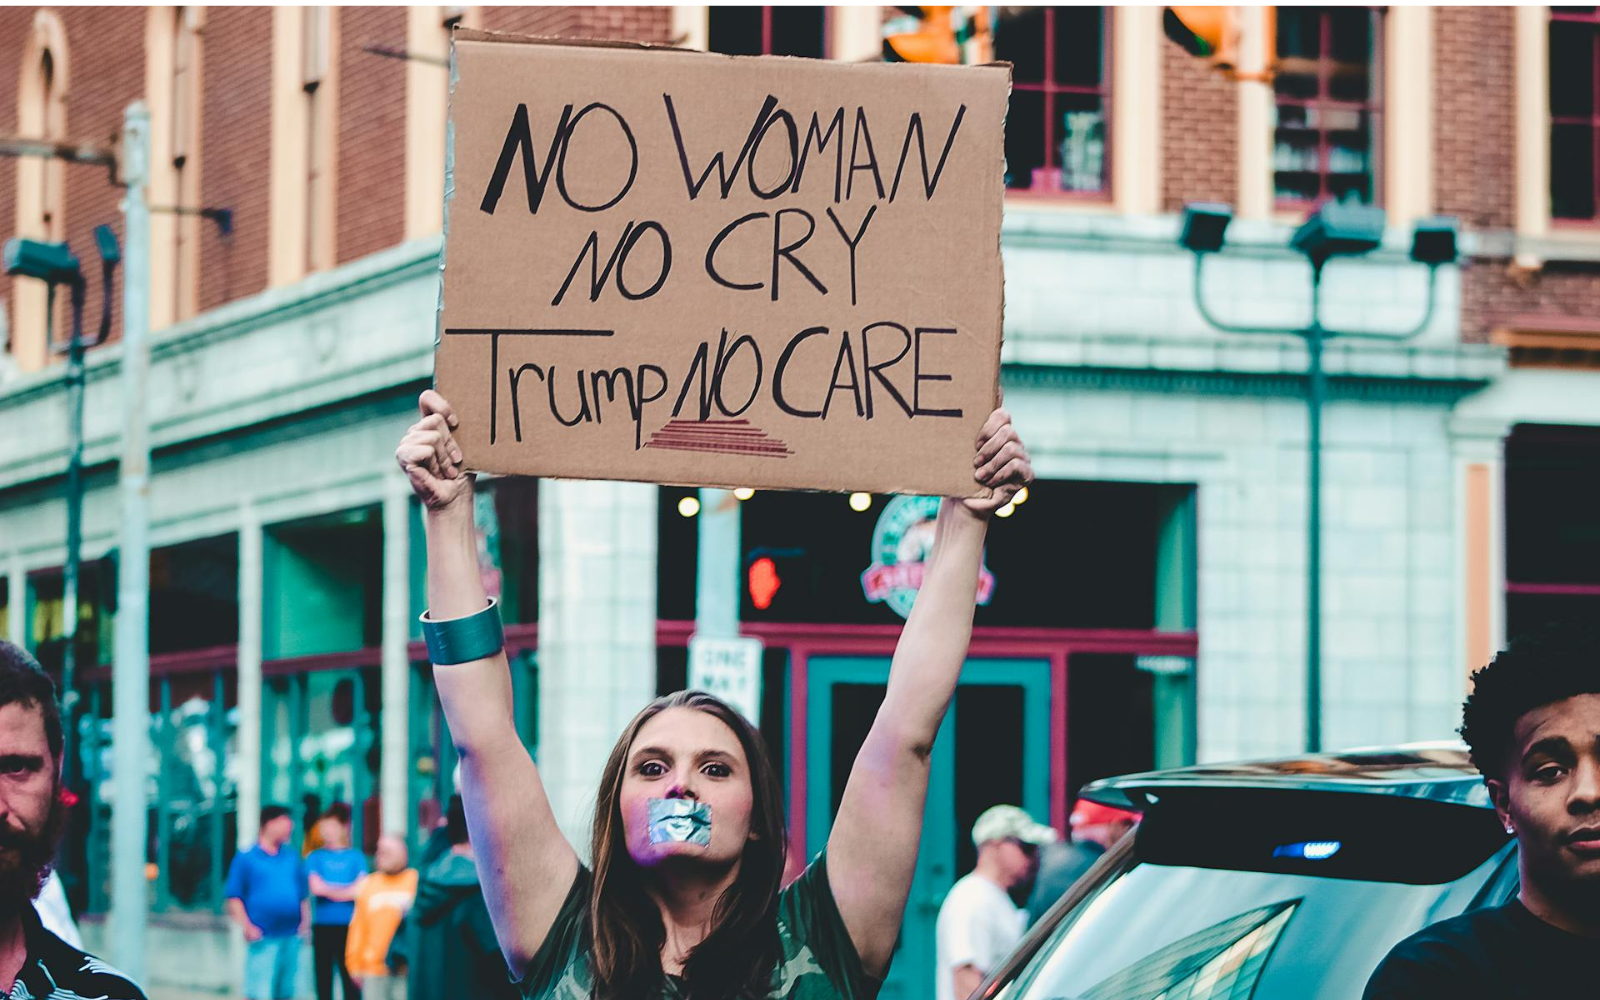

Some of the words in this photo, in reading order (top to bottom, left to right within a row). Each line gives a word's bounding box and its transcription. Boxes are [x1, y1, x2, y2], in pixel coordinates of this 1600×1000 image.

[480, 102, 638, 214] NO
[663, 92, 966, 203] WOMAN
[551, 219, 673, 306] NO
[705, 204, 877, 305] CRY
[445, 328, 668, 450] Trump
[671, 327, 763, 420] NO
[772, 321, 963, 420] CARE
